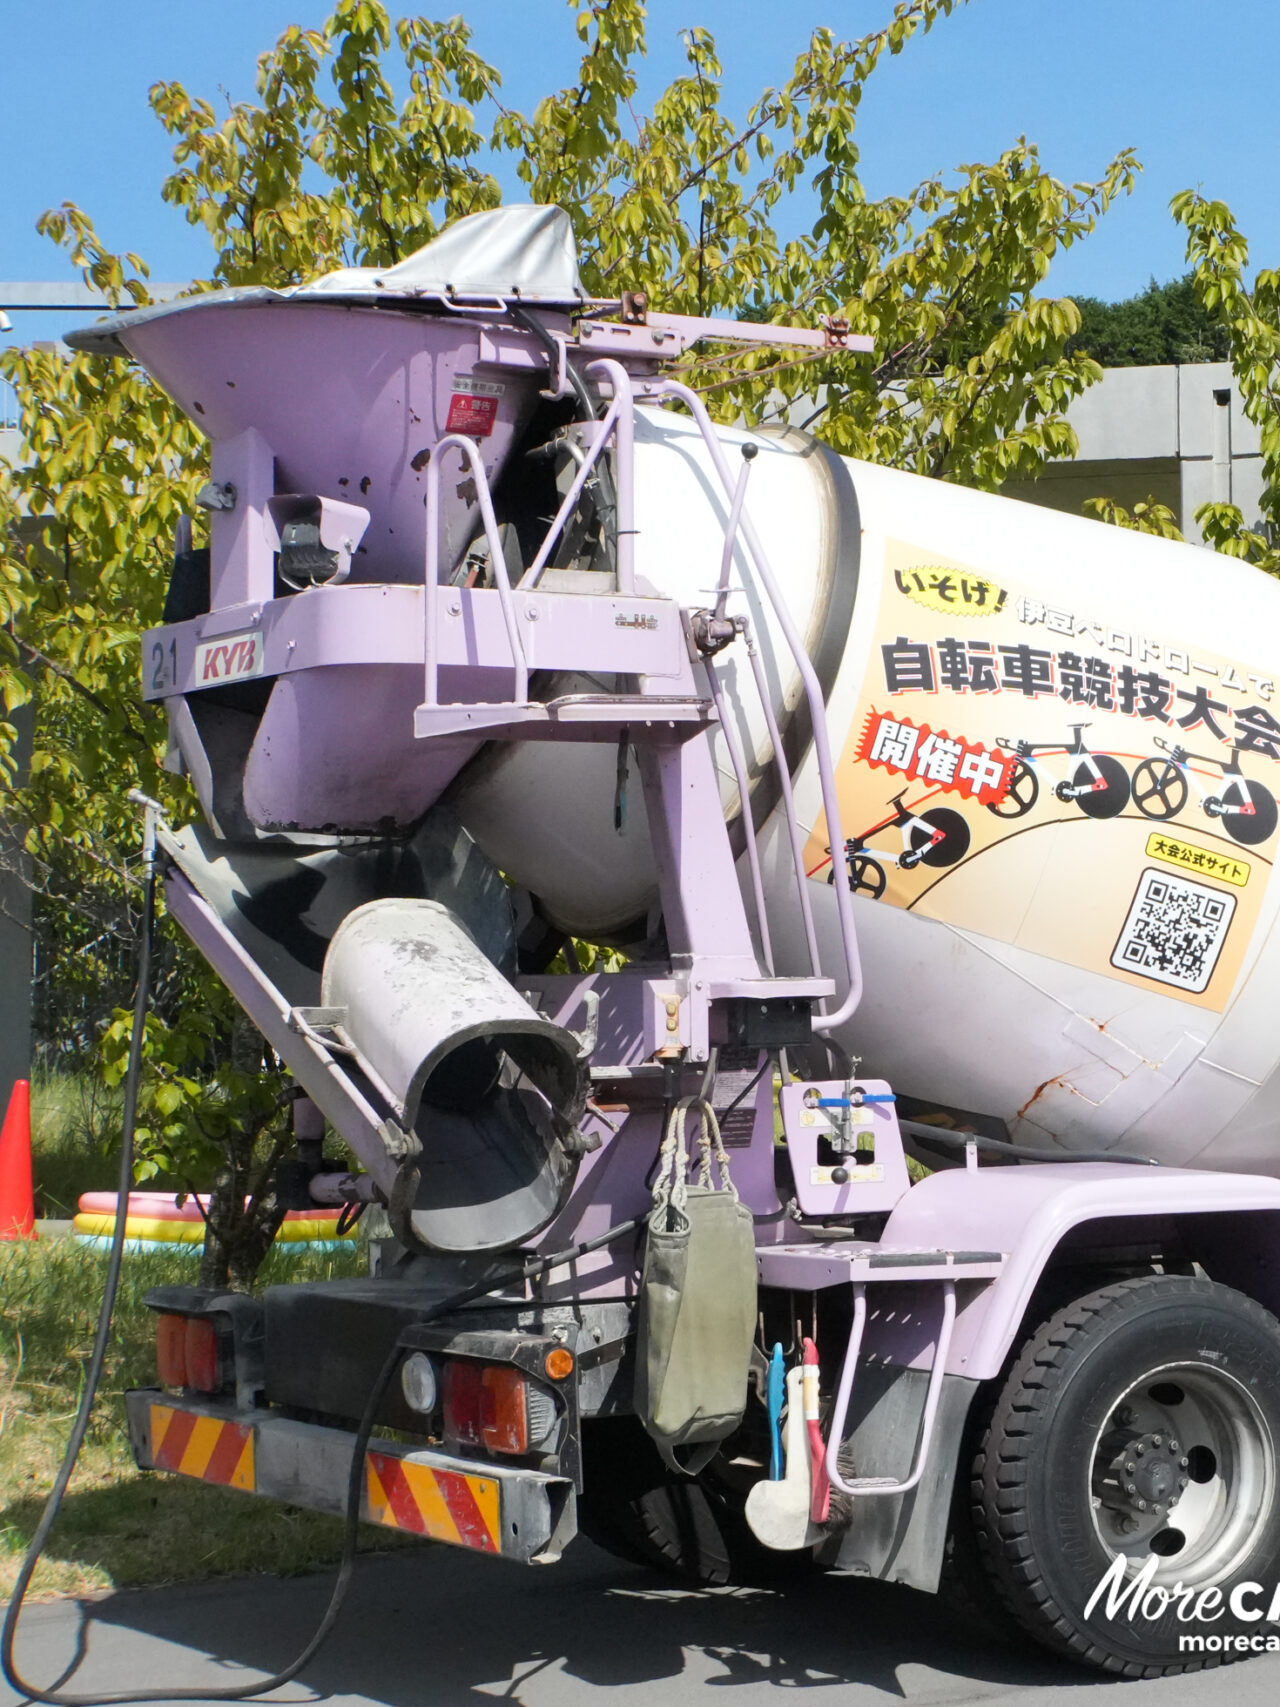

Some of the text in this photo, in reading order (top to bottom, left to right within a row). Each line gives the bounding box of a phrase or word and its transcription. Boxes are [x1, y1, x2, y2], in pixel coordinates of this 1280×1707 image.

[152, 637, 177, 690] 21
[203, 640, 256, 680] KYB
[1015, 595, 1275, 701] 伊豆ベロドロームで
[869, 717, 1004, 794] 開催中
[1154, 840, 1242, 878] 大会公式サイト
